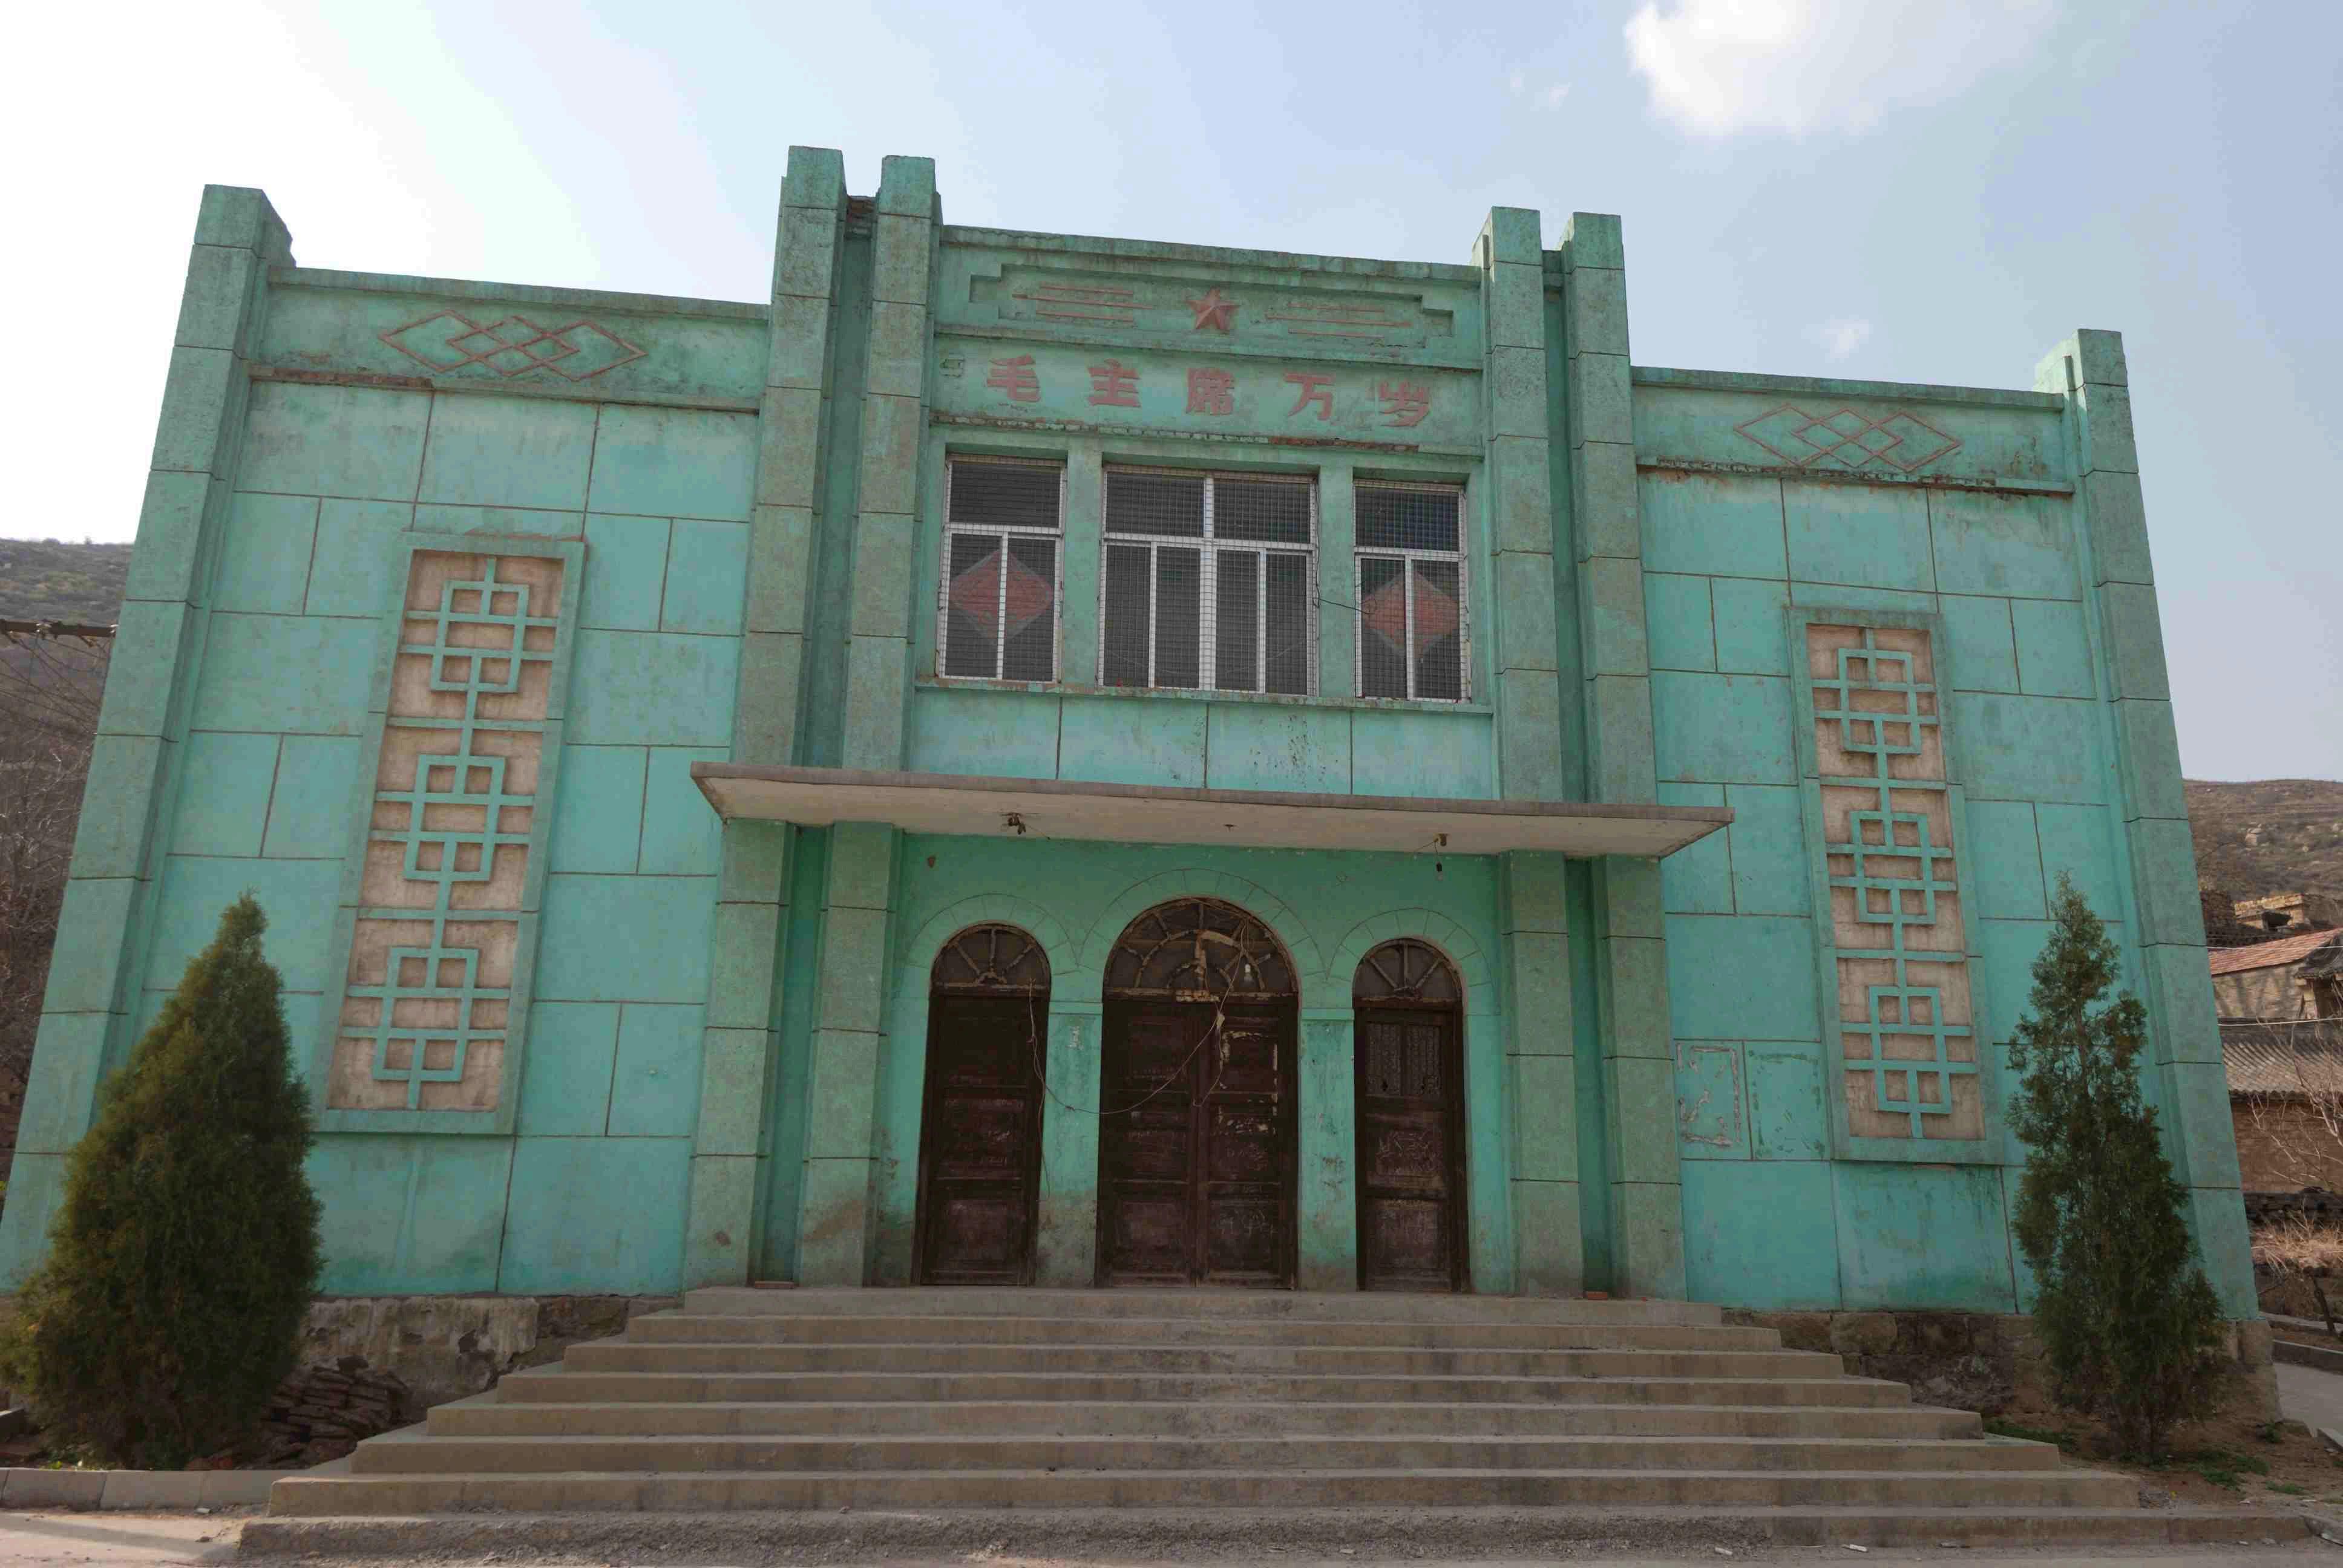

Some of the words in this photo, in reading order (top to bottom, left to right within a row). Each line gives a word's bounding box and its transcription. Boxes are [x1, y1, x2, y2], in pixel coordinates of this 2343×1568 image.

[986, 353, 1430, 428] 毛主席万岁
